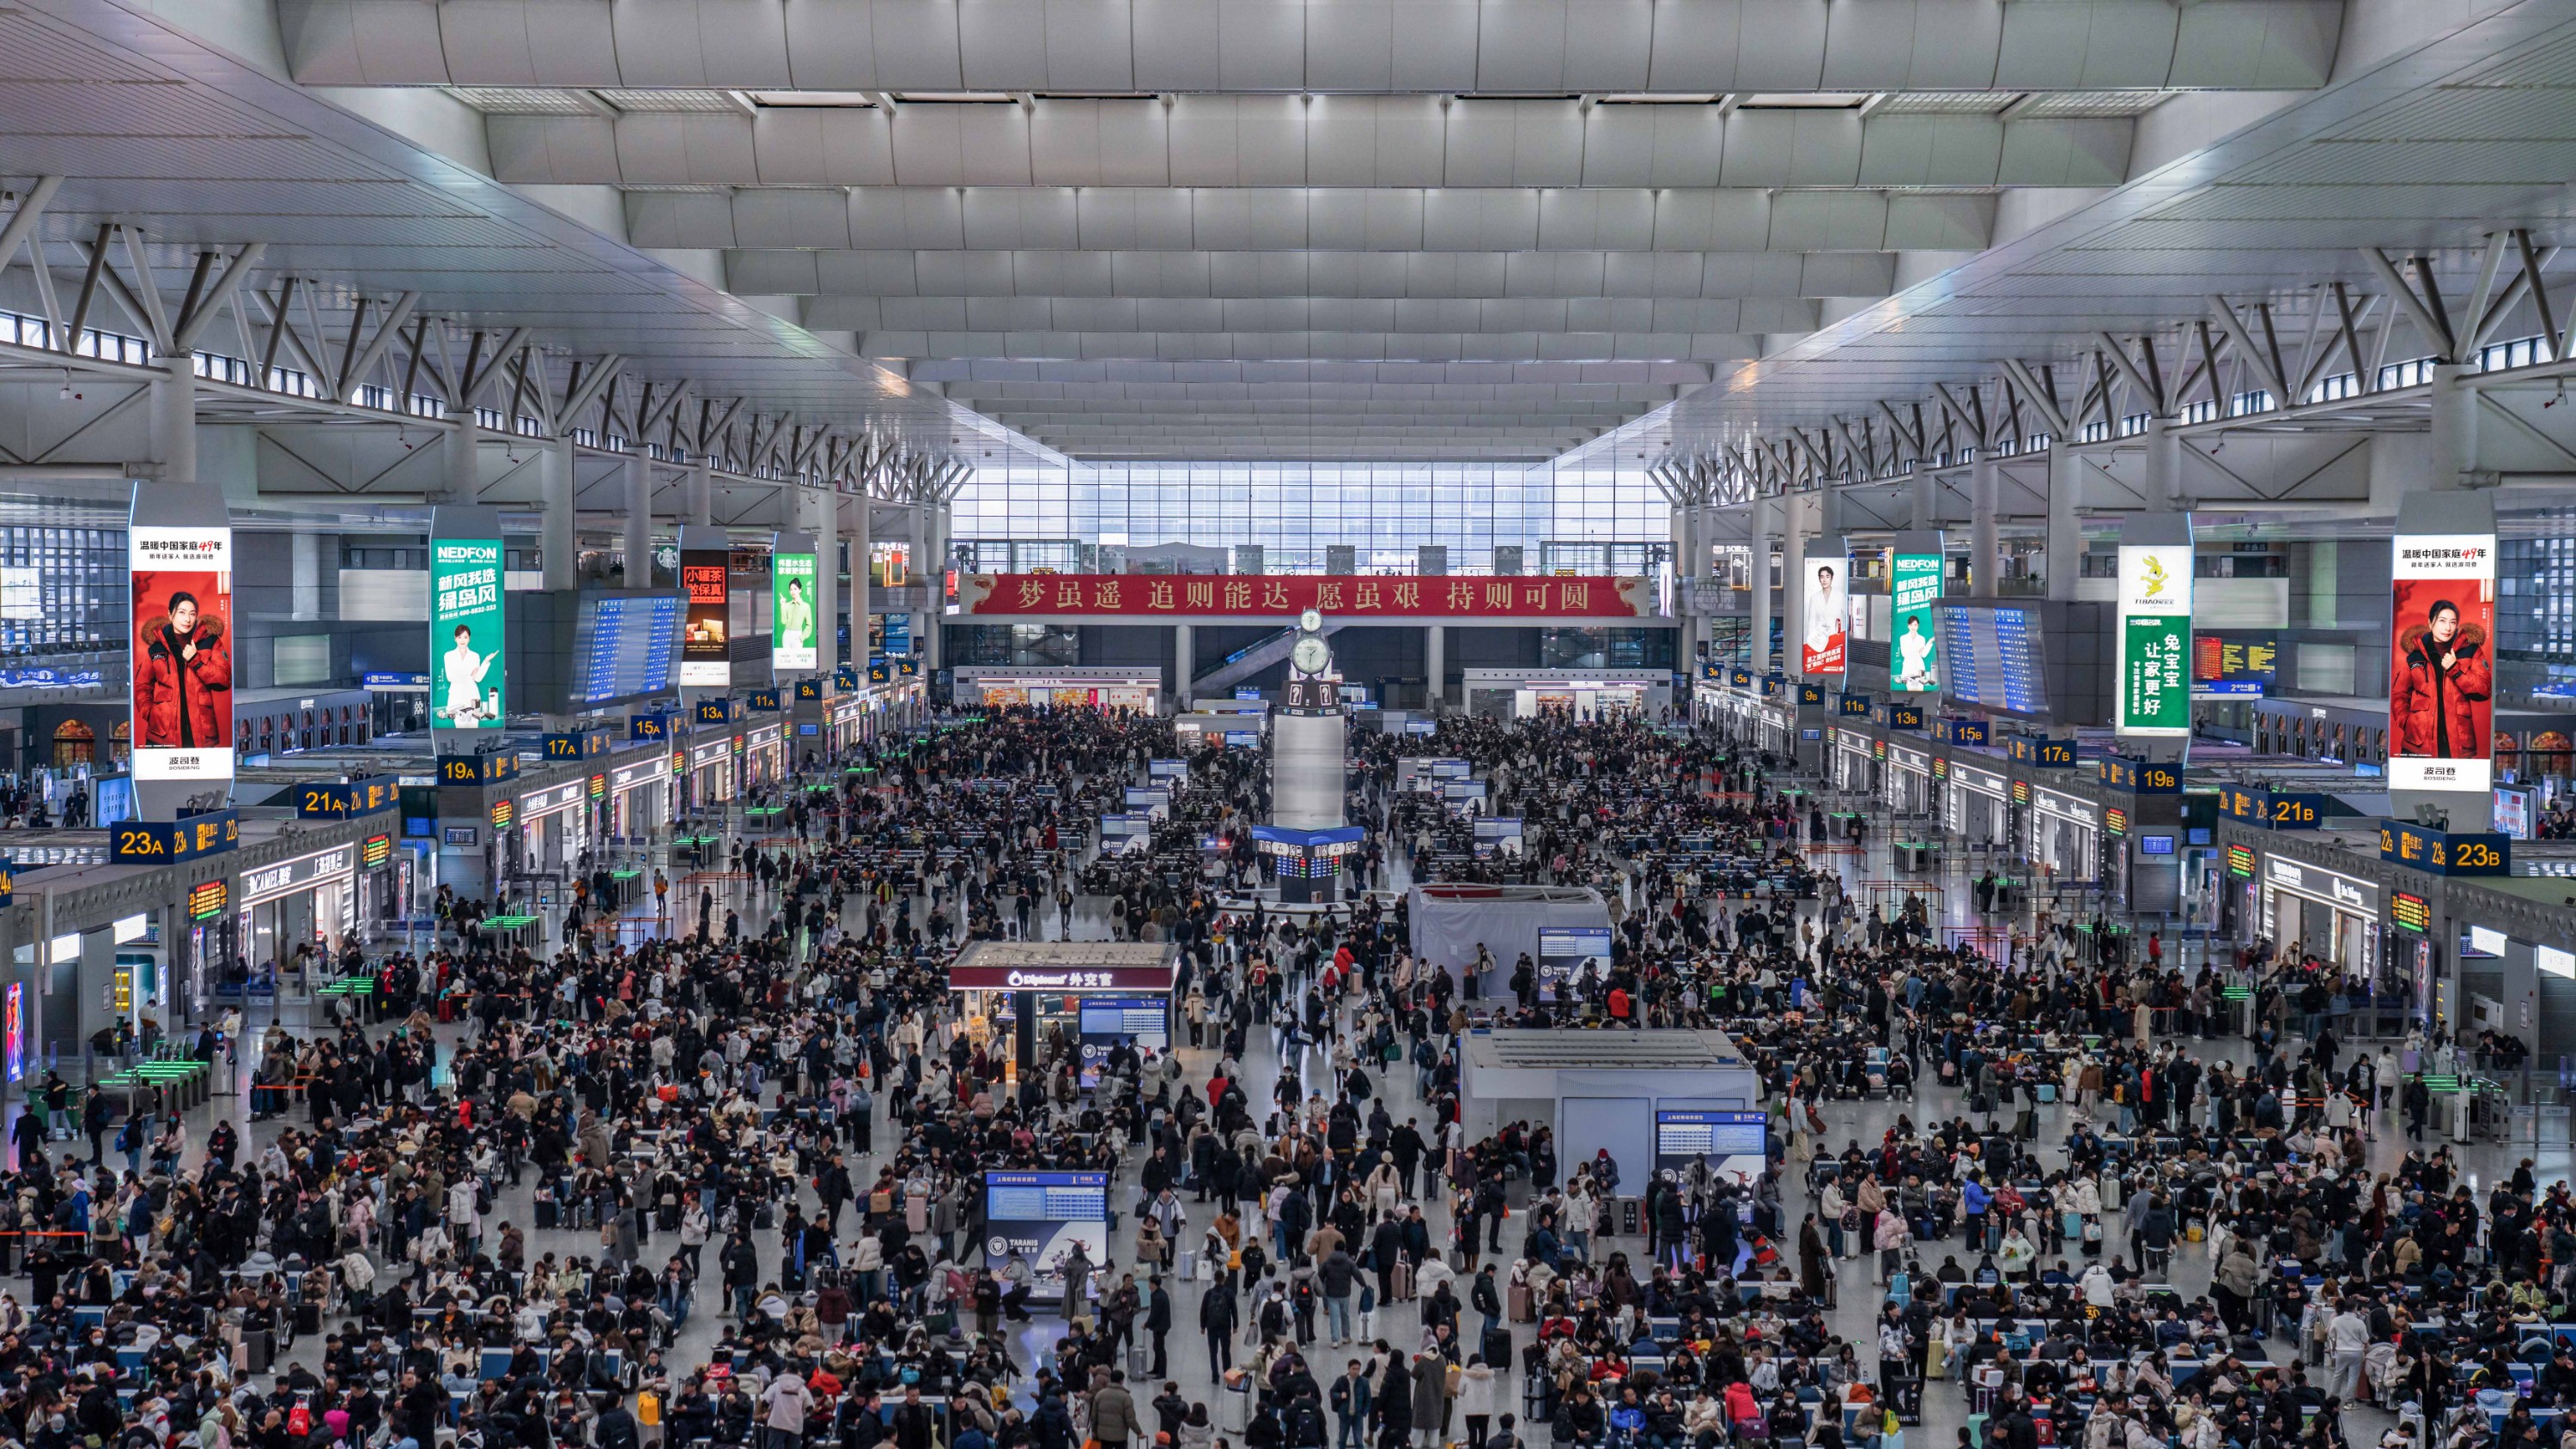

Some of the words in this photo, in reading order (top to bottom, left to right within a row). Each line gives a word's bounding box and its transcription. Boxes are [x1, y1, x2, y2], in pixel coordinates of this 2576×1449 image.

[140, 541, 222, 551] 温暖中国家庭49年
[437, 547, 496, 559] NEDFON
[2403, 548, 2486, 559] 温暖中国家庭49年
[1897, 560, 1939, 568] NEDFON
[439, 568, 495, 591] 新风我选
[687, 570, 722, 582] 小罐茶
[1897, 575, 1938, 591] 新风我选
[439, 584, 496, 611] 绿岛风
[1018, 580, 1121, 609] 梦虽遥
[1147, 580, 1289, 609] 追则能达
[1316, 581, 1420, 609] 愿虽艰
[1446, 582, 1588, 610] 持则可圆
[2163, 634, 2180, 687] 兔宝宝
[872, 670, 884, 679] 5A
[2143, 642, 2161, 715] 让家更好
[840, 678, 851, 687] 7A
[802, 686, 814, 696] 9A
[1806, 690, 1818, 700] 9B
[756, 695, 775, 706] 11A
[1845, 700, 1864, 711] 11B
[702, 707, 723, 718] 13A
[1895, 712, 1917, 724] 13B
[637, 721, 660, 734] 15A
[1959, 727, 1982, 740] 15B
[549, 740, 576, 755] 17A
[2043, 747, 2070, 761] 17B
[445, 762, 475, 779] 19A
[2424, 767, 2456, 775] 波司登
[2145, 771, 2174, 787] 19B
[306, 792, 342, 811] 21A
[2276, 802, 2314, 821] 21B
[226, 820, 238, 841] 22A
[120, 832, 164, 854] 23A
[174, 831, 187, 853] 23A
[2381, 829, 2393, 852] 22B
[2433, 841, 2445, 864] 23B
[2457, 844, 2500, 866] 23B
[1069, 973, 1113, 986] 外交官
